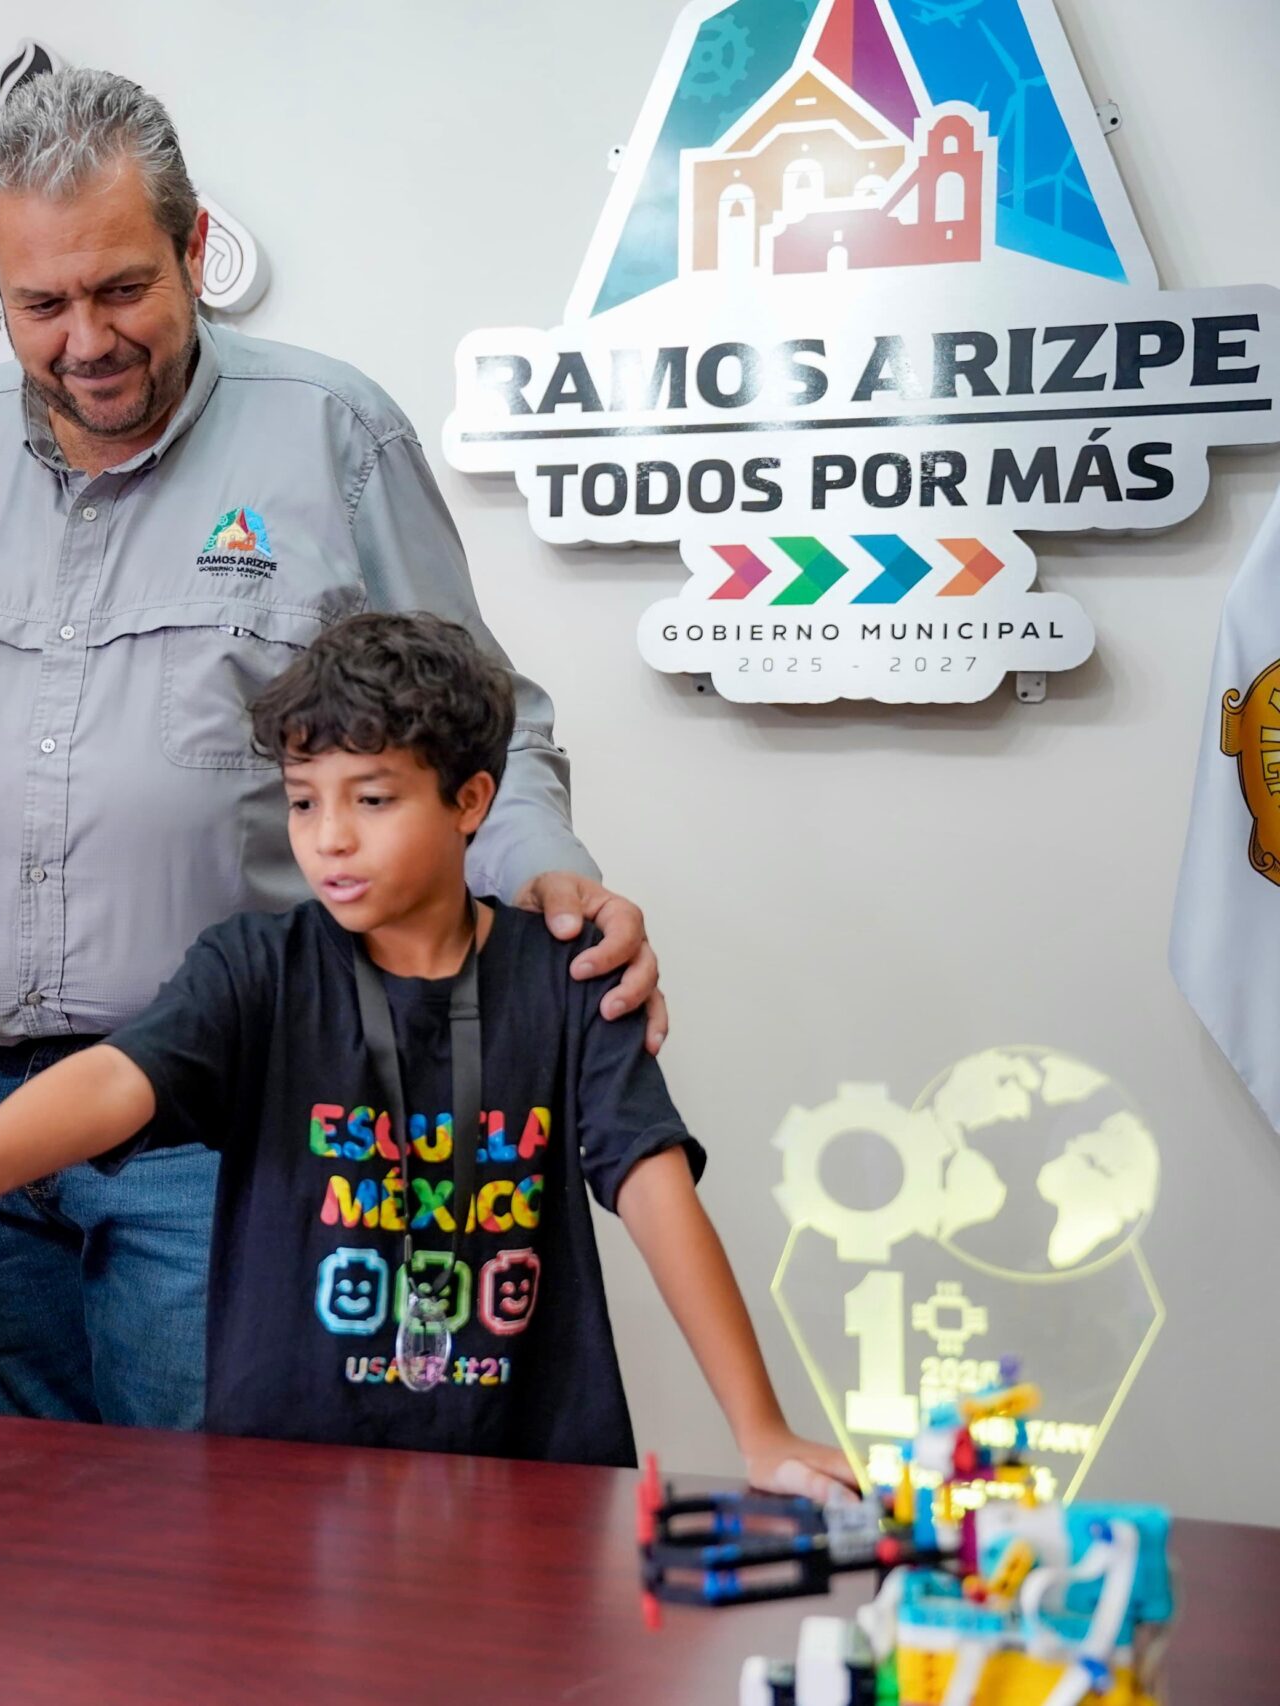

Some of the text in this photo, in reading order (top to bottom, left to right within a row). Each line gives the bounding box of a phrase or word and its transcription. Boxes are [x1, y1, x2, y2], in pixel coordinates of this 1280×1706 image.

[475, 314, 1261, 416] RAMOS ARIZPE
[536, 427, 1175, 518] TODOS POR MÁS
[196, 556, 277, 571] RAMOS ARIZPE
[662, 621, 1065, 642] GOBIERNO MUNICIPAL
[737, 657, 824, 673] 2025
[889, 656, 979, 674] 2027
[844, 1270, 920, 1439] 1
[452, 1355, 512, 1386] #21
